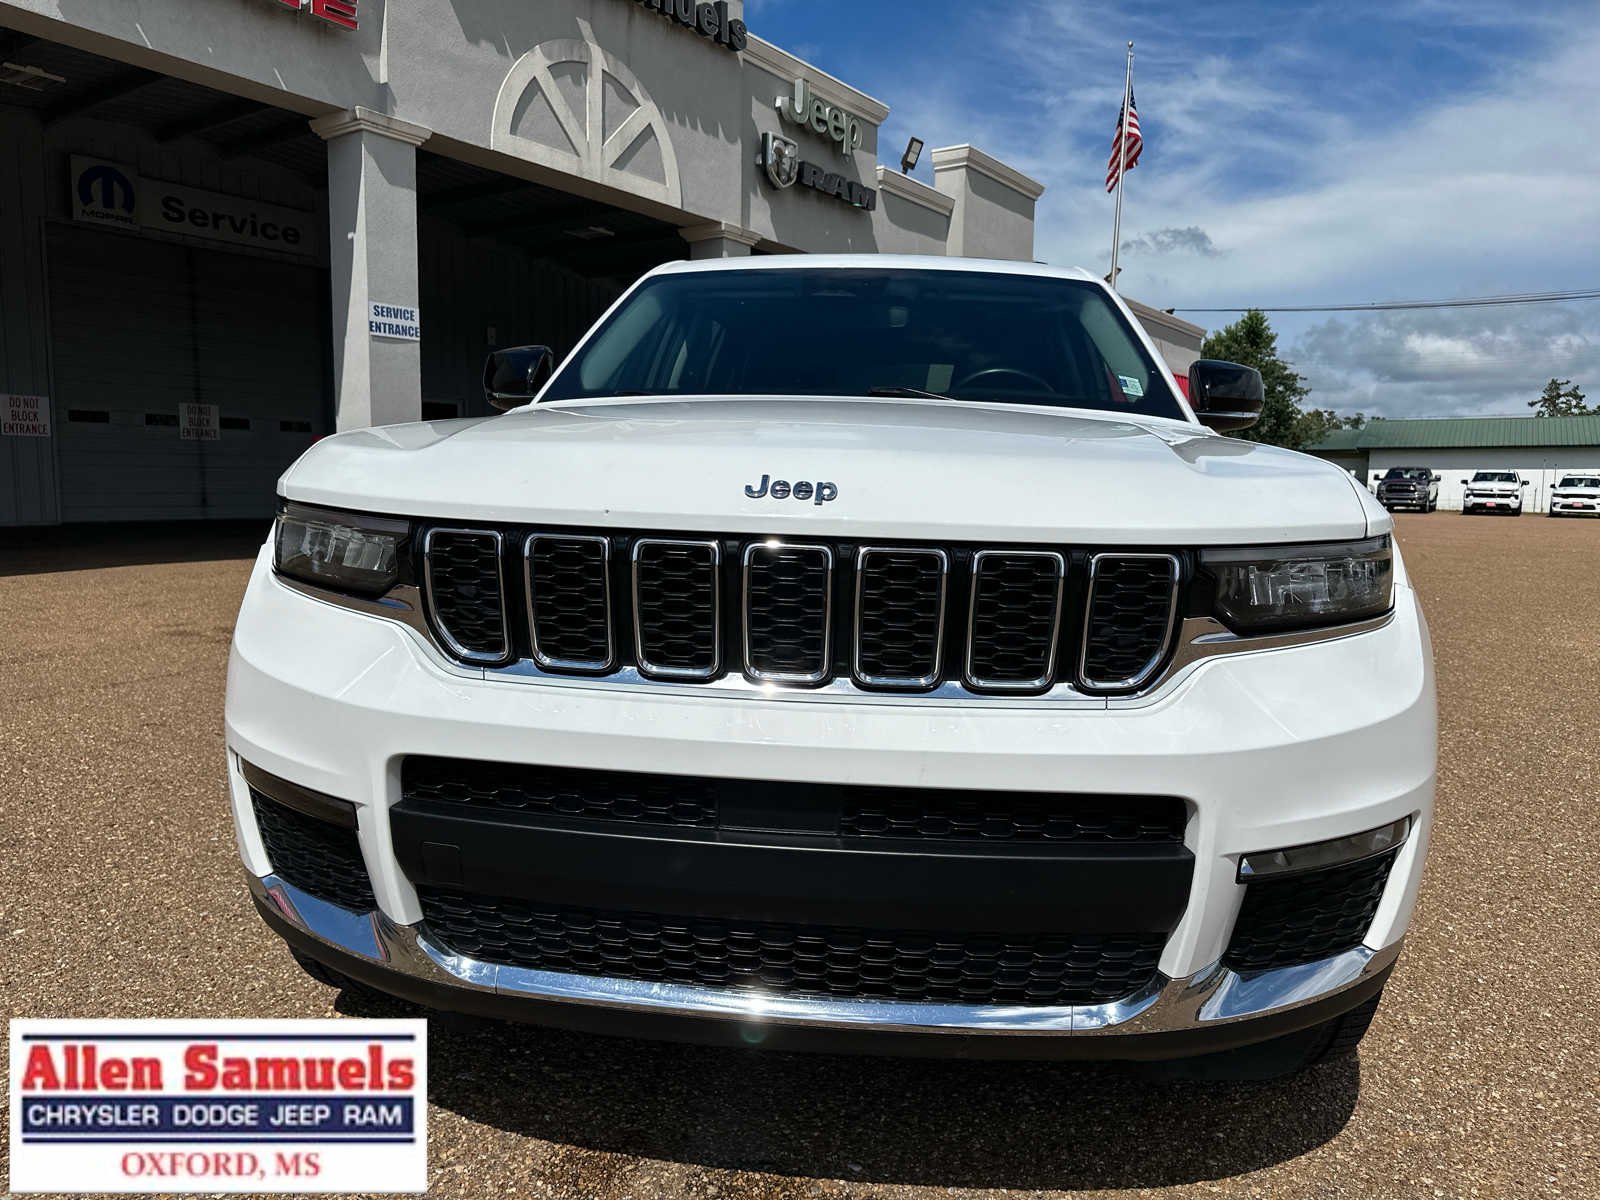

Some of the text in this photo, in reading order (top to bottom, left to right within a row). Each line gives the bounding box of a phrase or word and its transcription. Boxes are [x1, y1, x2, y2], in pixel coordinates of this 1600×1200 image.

[775, 78, 862, 160] Jeep
[799, 160, 876, 211] RAM
[161, 196, 300, 245] Service
[373, 304, 415, 322] SERVICE
[369, 320, 420, 338] ENTRANCE
[23, 397, 40, 409] NOT
[11, 410, 39, 422] BLOCK
[3, 422, 49, 435] ENTRANCE
[744, 474, 838, 506] Jeep
